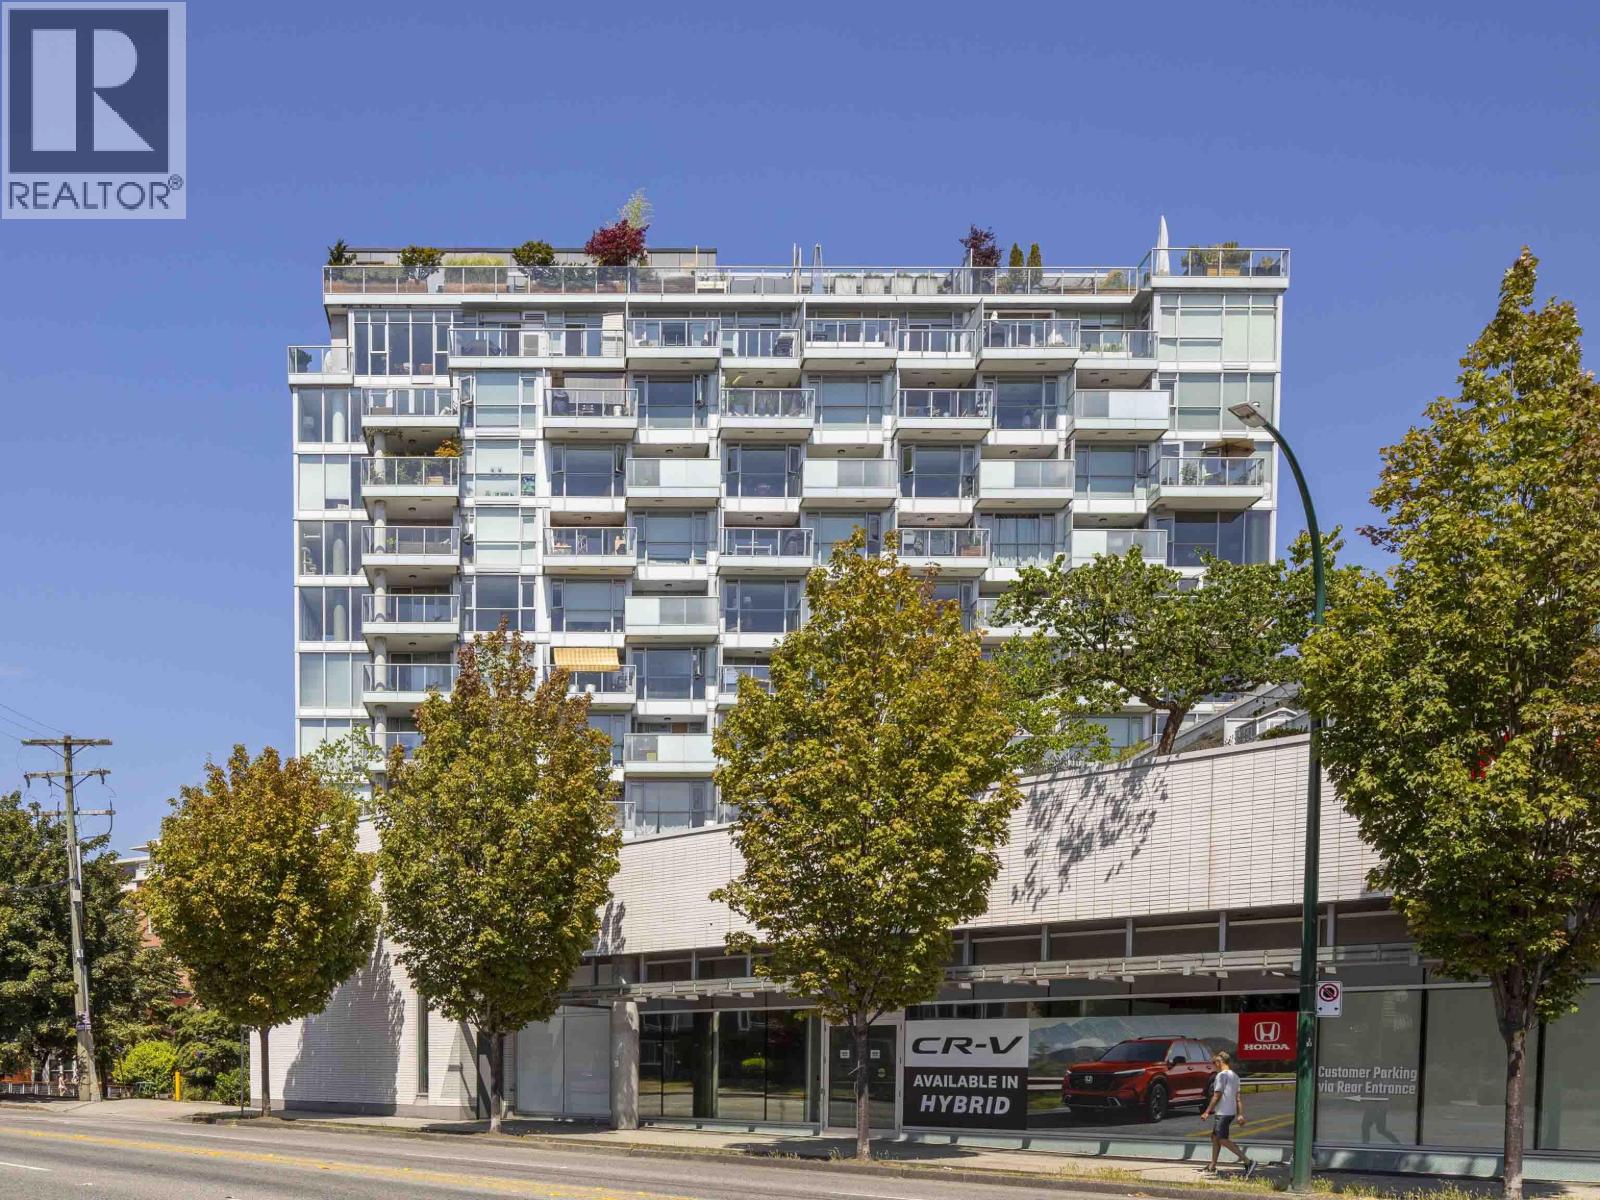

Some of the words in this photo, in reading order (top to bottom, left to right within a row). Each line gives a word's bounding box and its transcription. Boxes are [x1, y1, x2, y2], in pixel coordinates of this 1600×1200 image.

[911, 1035, 1024, 1055] CR-V
[1243, 1043, 1291, 1051] HONDA
[1318, 1066, 1371, 1079] Customer
[1373, 1066, 1418, 1081] Parking
[913, 1074, 997, 1089] AVAILABLE
[1001, 1075, 1019, 1089] IN
[1318, 1080, 1334, 1093] via
[1337, 1081, 1362, 1093] Rear
[1365, 1081, 1416, 1095] Entrance
[920, 1094, 1011, 1115] HYBRID
